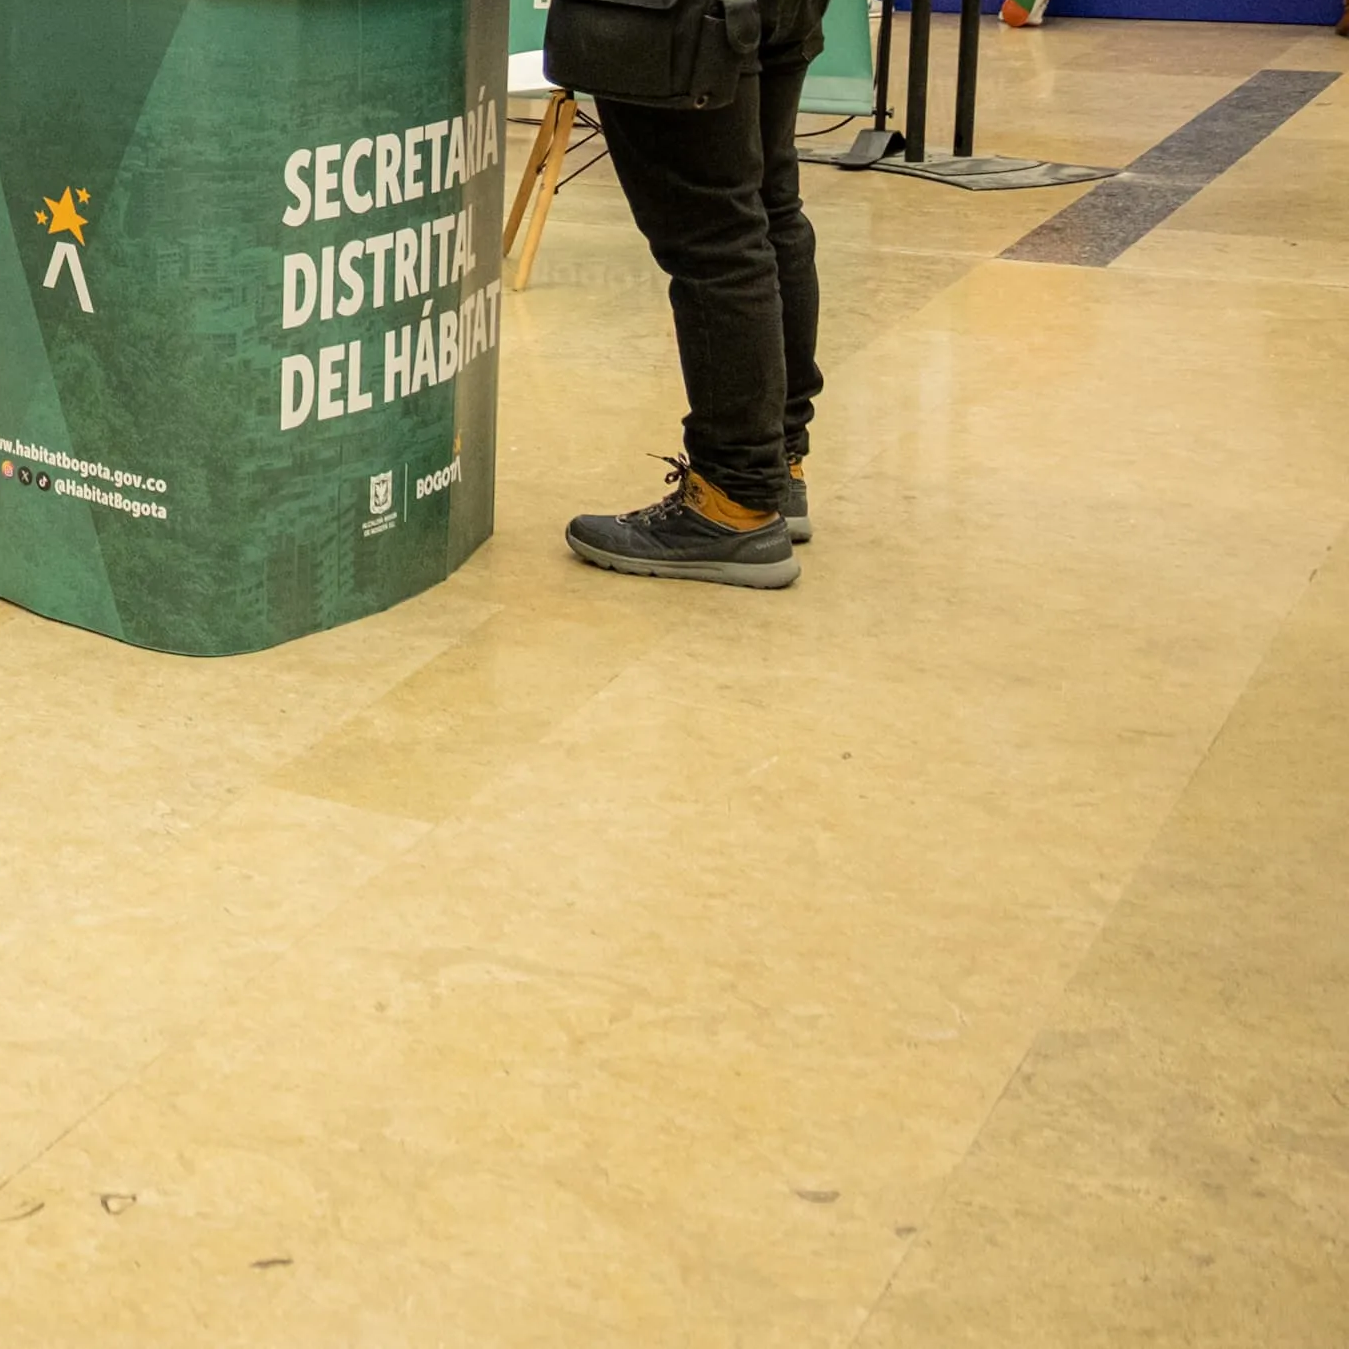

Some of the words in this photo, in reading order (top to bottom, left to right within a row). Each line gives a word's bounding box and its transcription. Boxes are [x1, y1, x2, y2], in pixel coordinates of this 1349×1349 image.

[281, 85, 498, 227] SECRETARÍA
[281, 203, 476, 330] DISTRITAL
[280, 339, 373, 431] DEL
[383, 278, 501, 403] HÁBITAT
[54, 478, 168, 520] @HabitatBogota
